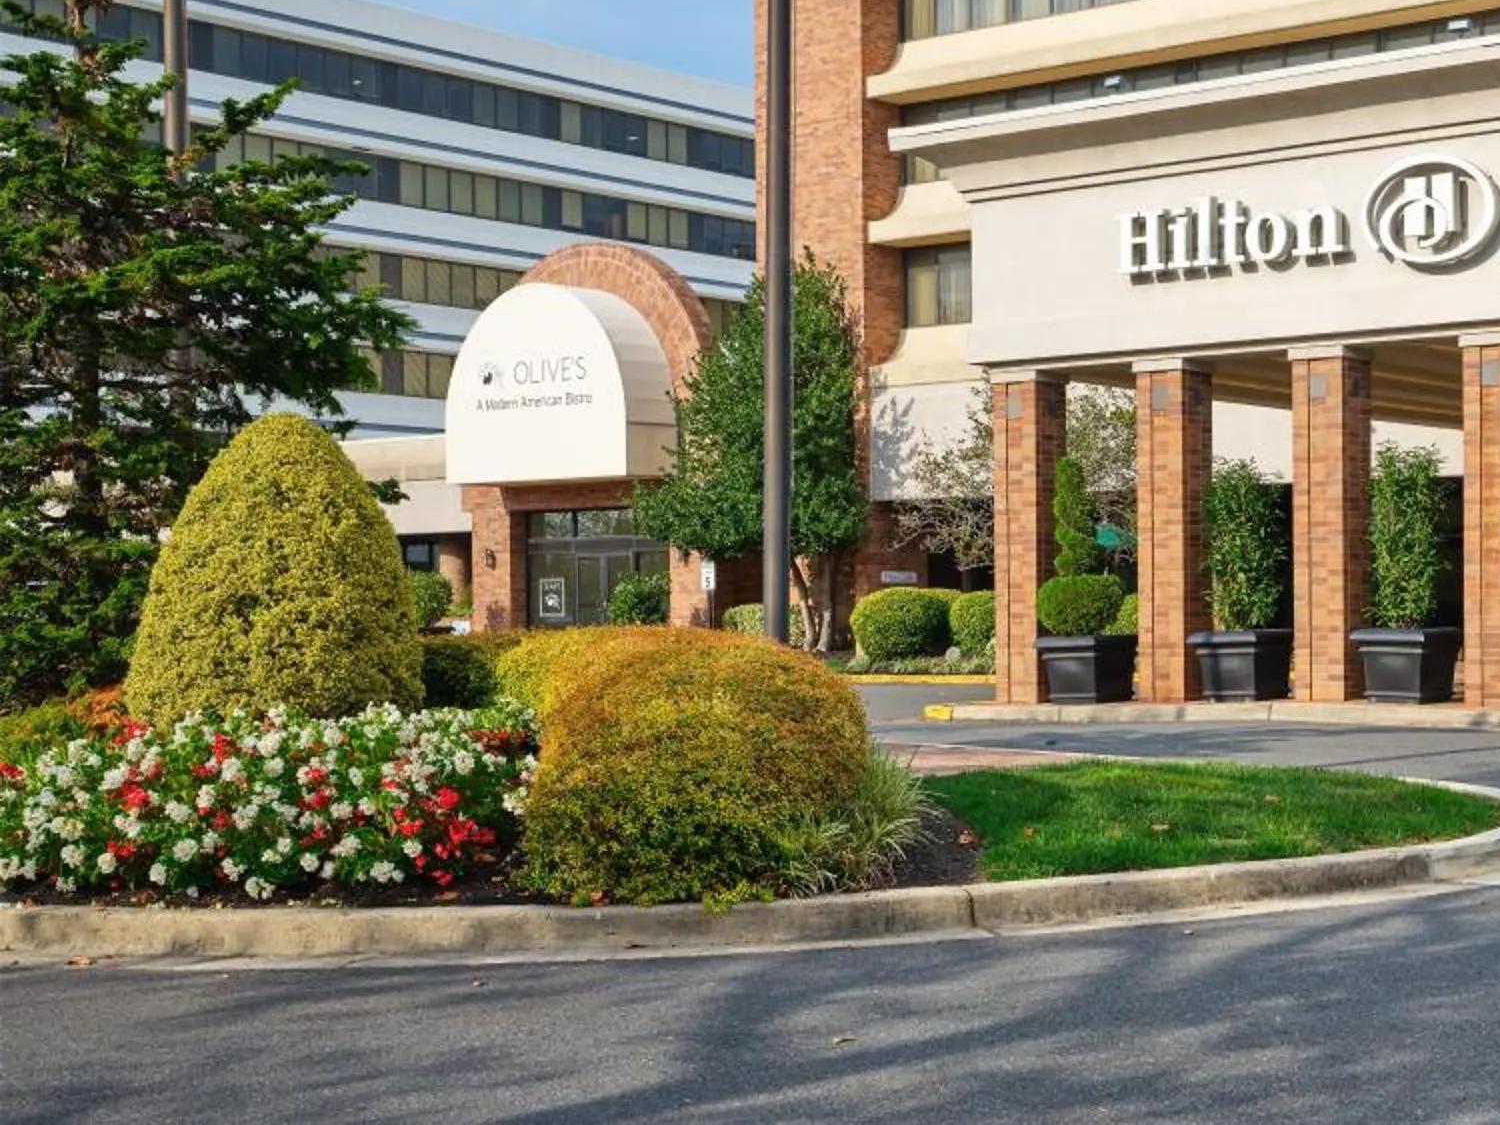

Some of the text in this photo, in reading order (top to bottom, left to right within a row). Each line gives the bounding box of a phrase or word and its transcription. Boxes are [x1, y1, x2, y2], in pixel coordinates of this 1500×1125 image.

[1115, 195, 1349, 277] Hilton
[476, 391, 593, 412] A Modern American Bistro
